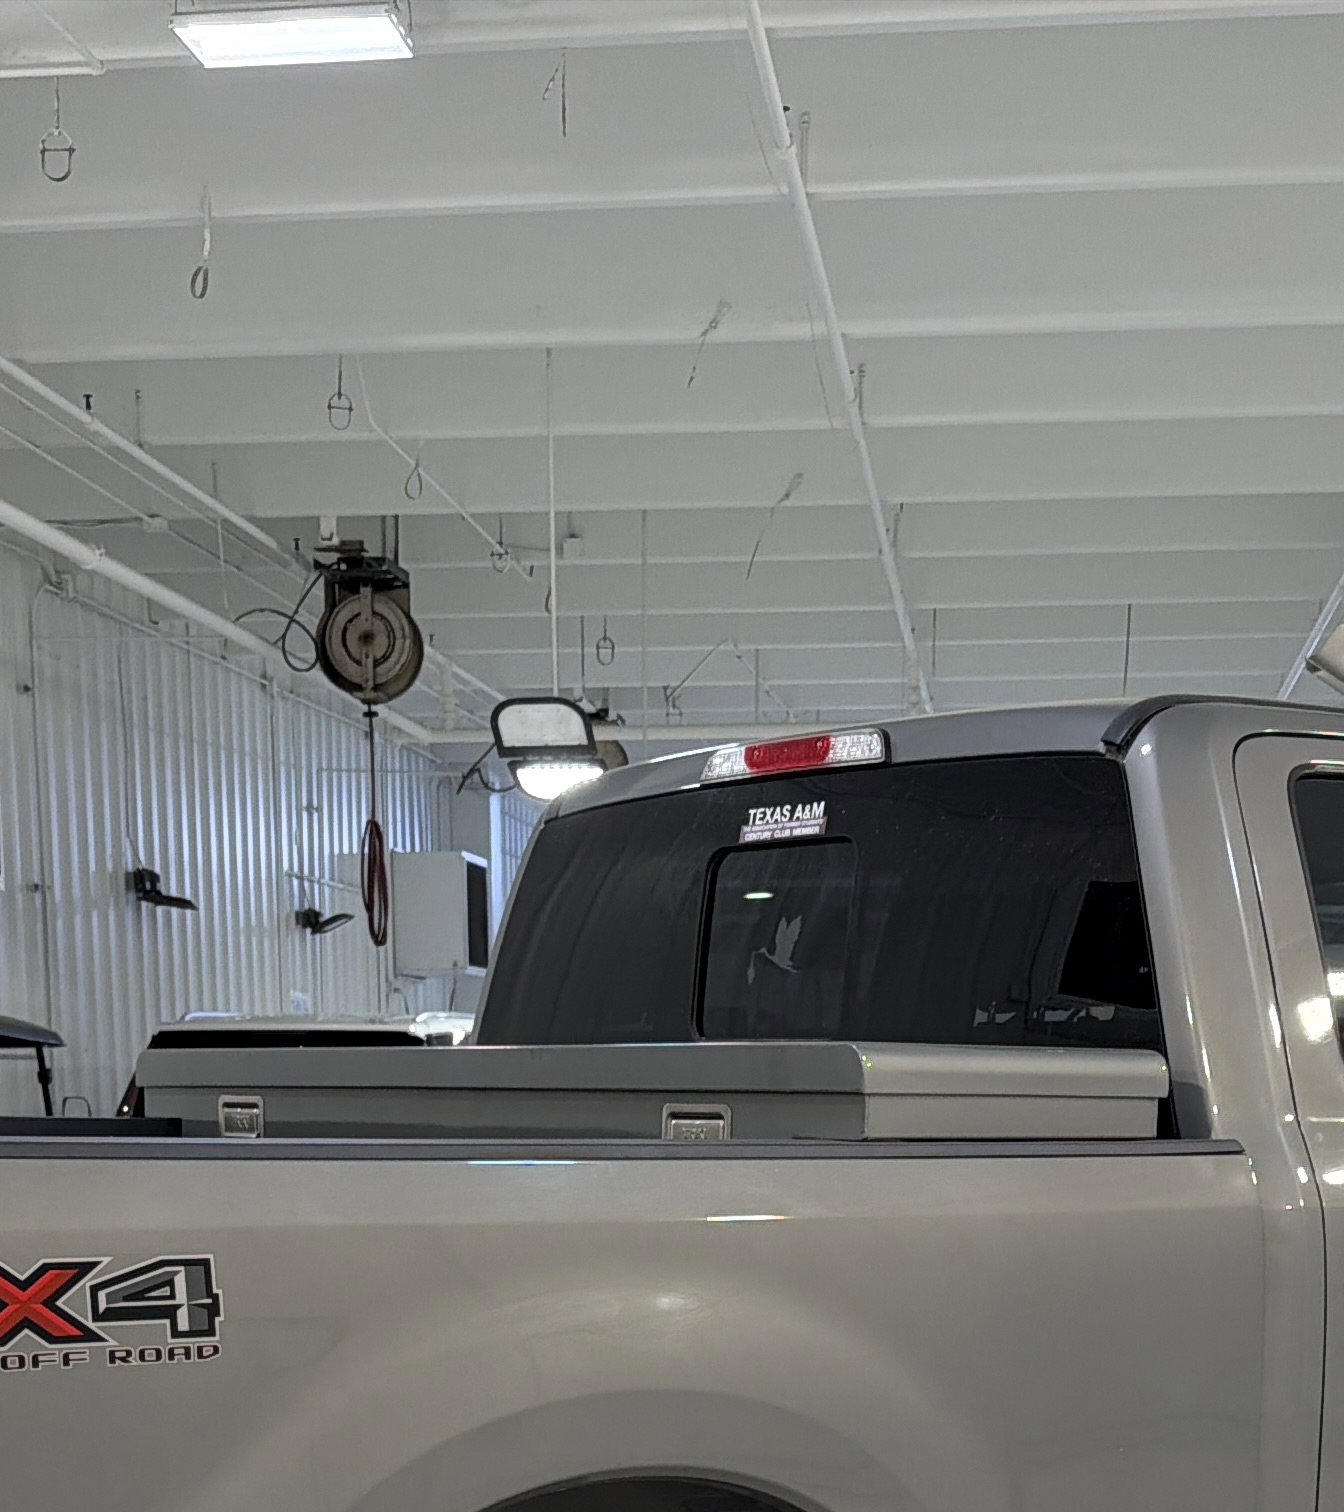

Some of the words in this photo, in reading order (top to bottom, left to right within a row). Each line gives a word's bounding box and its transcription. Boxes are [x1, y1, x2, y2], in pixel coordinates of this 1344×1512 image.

[748, 804, 791, 826] TEXAS
[793, 801, 825, 821] A&M
[0, 1349, 89, 1372] OFF
[107, 1343, 223, 1367] ROAD
